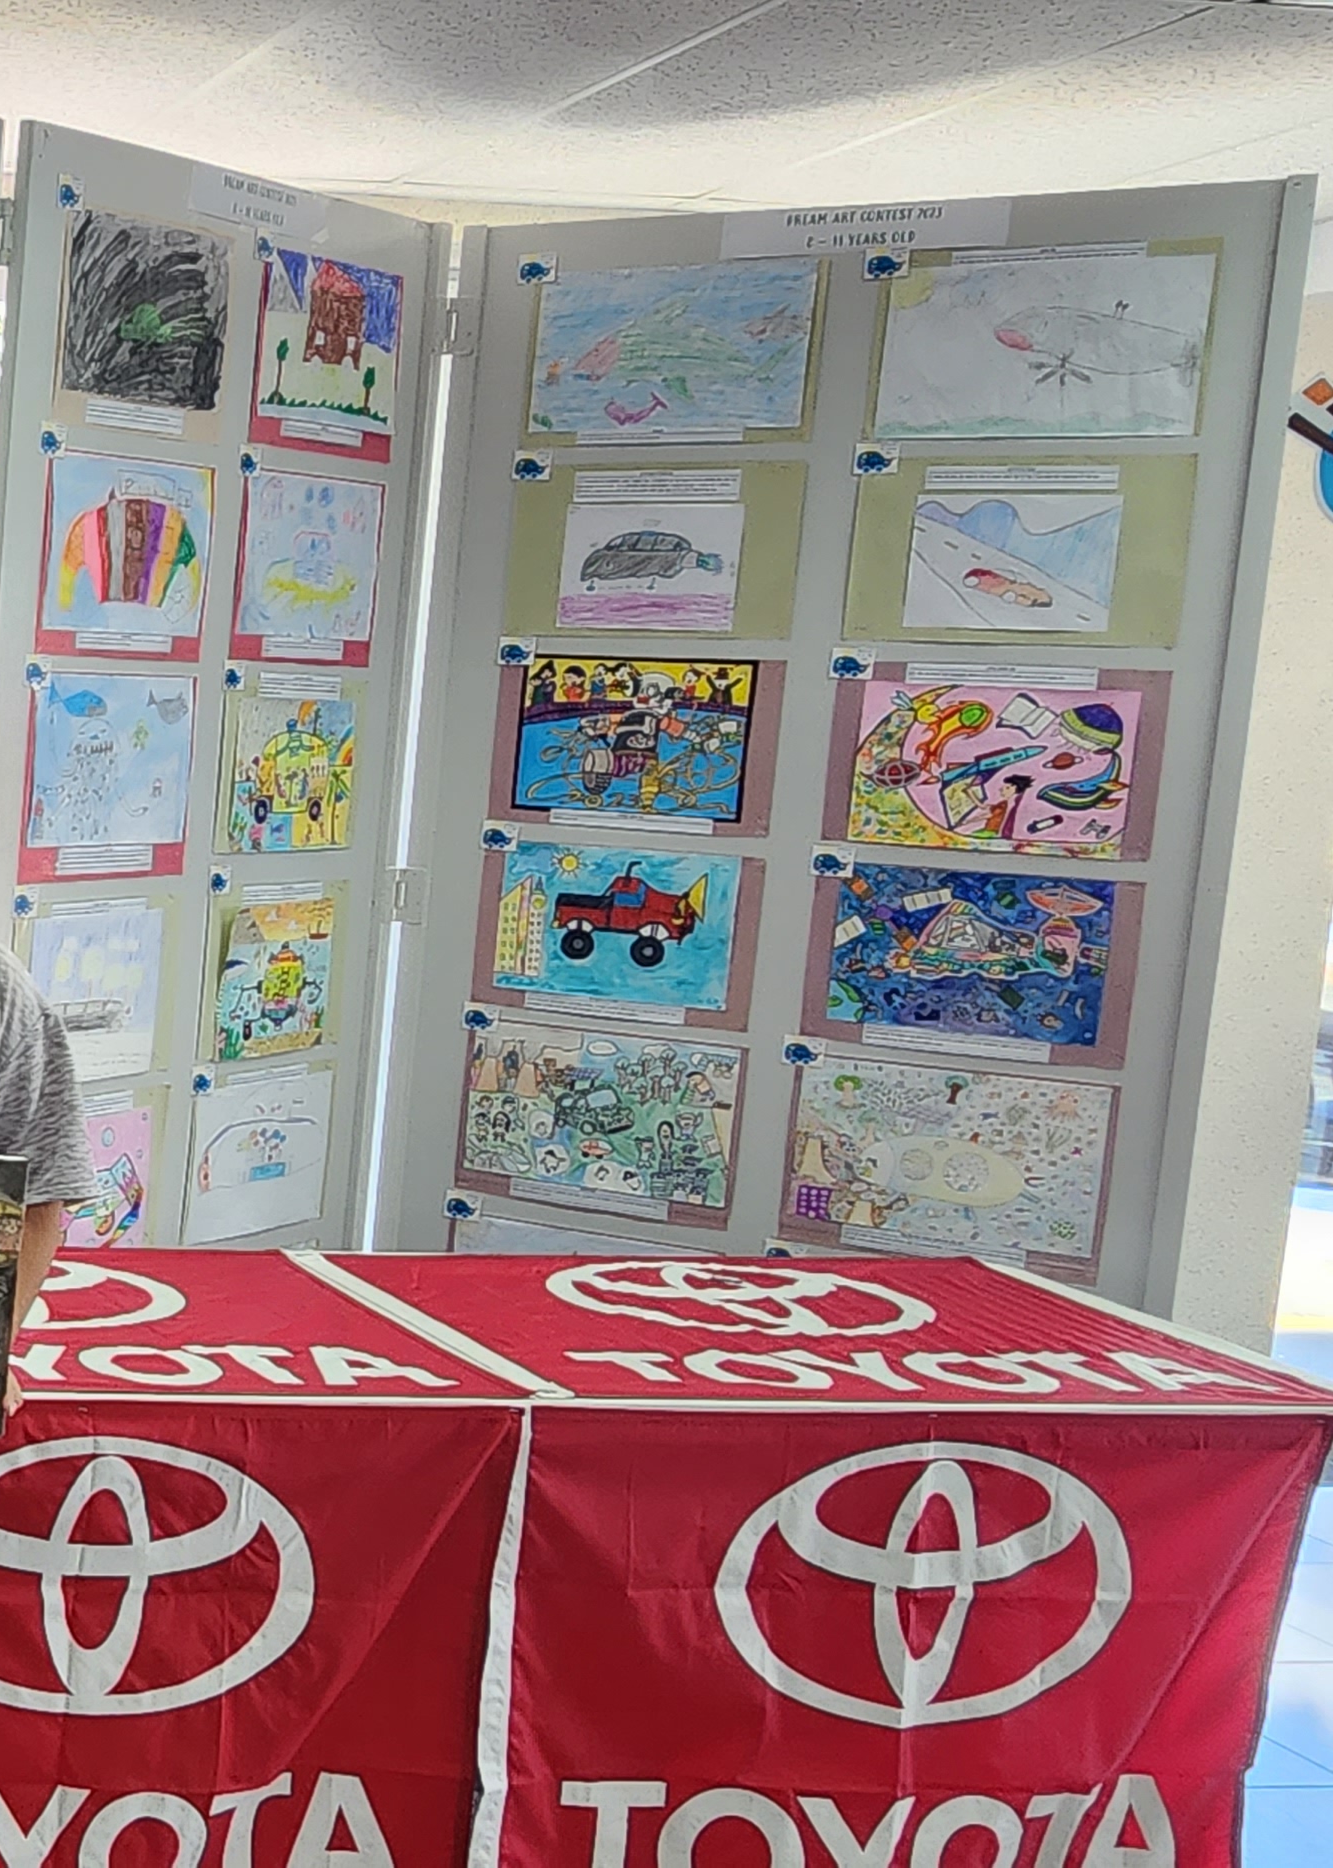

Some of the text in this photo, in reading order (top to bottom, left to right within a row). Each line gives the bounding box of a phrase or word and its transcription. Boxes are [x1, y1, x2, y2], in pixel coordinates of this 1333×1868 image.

[787, 211, 828, 228] DREAM
[832, 210, 857, 225] ART
[860, 207, 914, 223] CONTEST
[848, 231, 888, 247] YEARS
[563, 1349, 1278, 1394] TOYOTA
